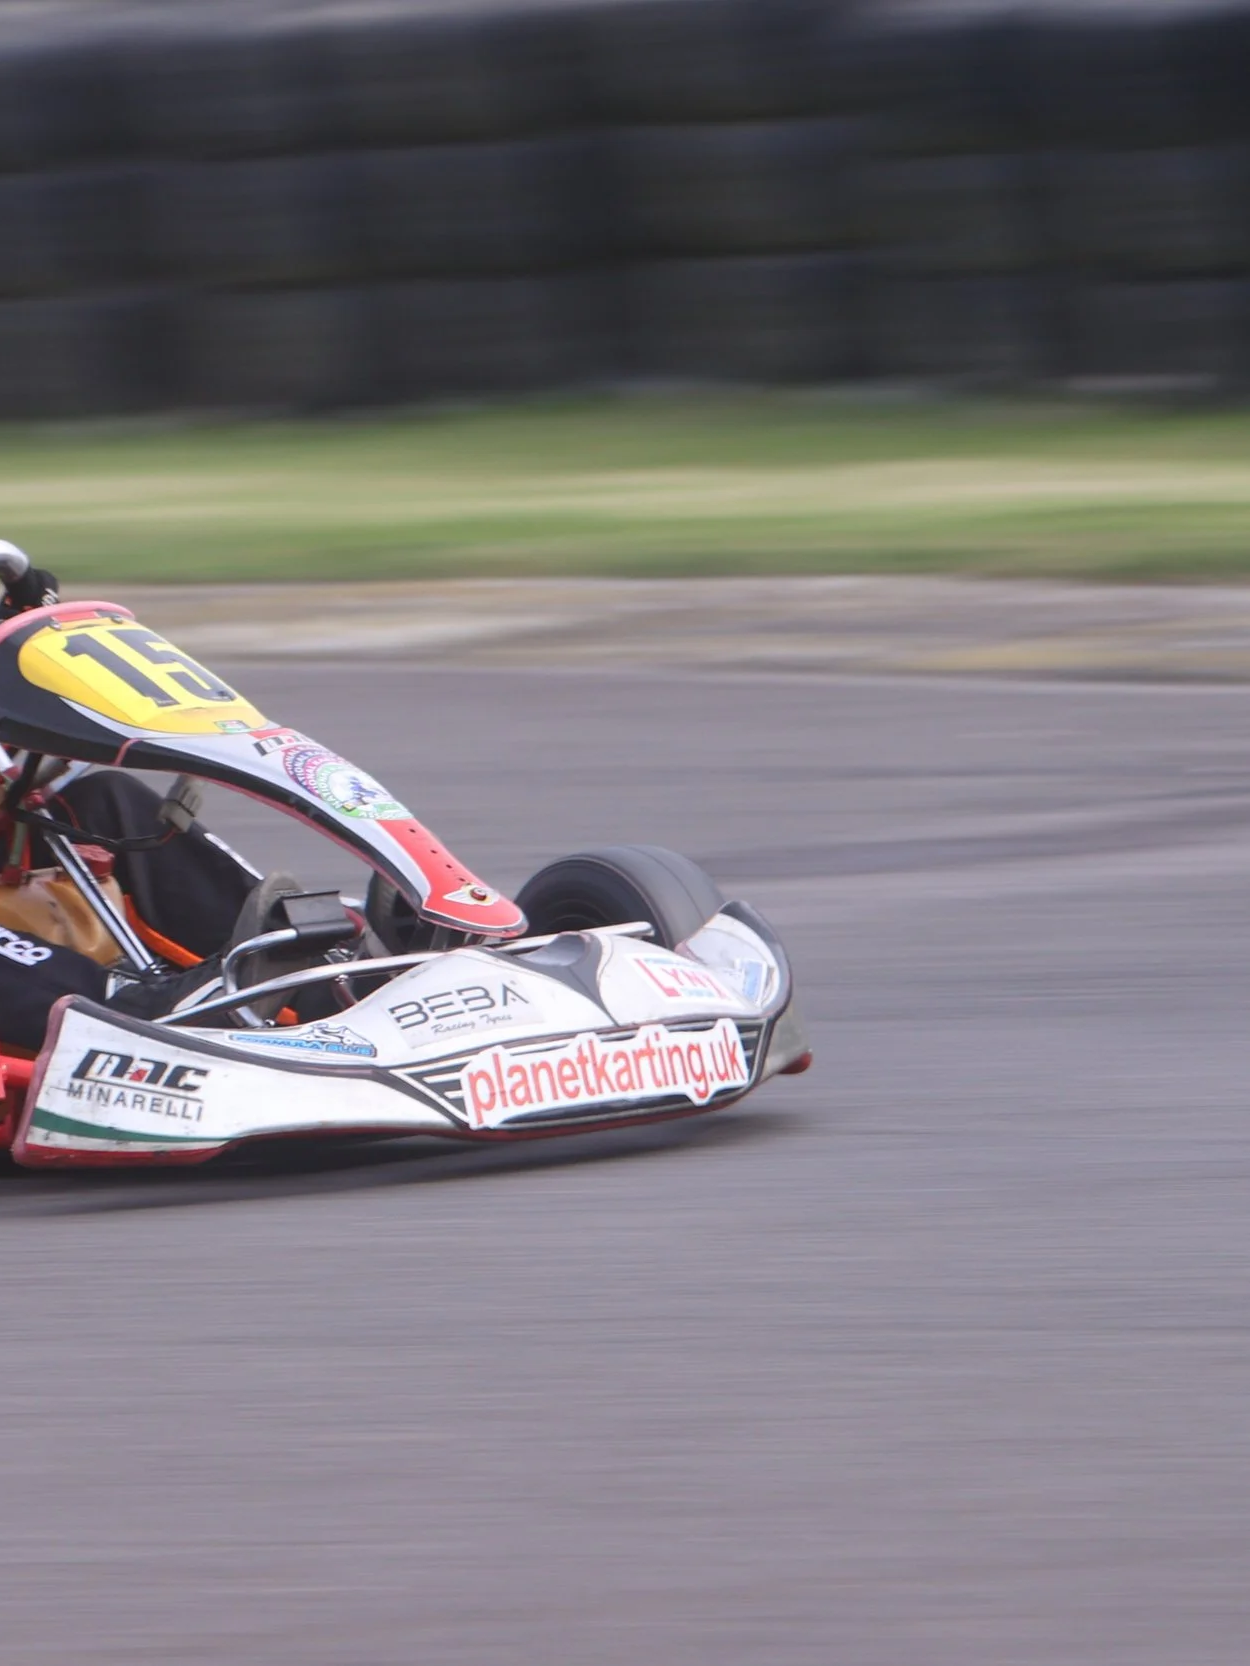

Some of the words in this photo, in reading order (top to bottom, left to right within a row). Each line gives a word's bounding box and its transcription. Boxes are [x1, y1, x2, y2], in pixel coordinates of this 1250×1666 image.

[62, 628, 235, 708] 15
[388, 985, 530, 1030] BEBA
[66, 1081, 205, 1122] MINARELLI
[468, 1026, 745, 1126] planetkarting.uk
